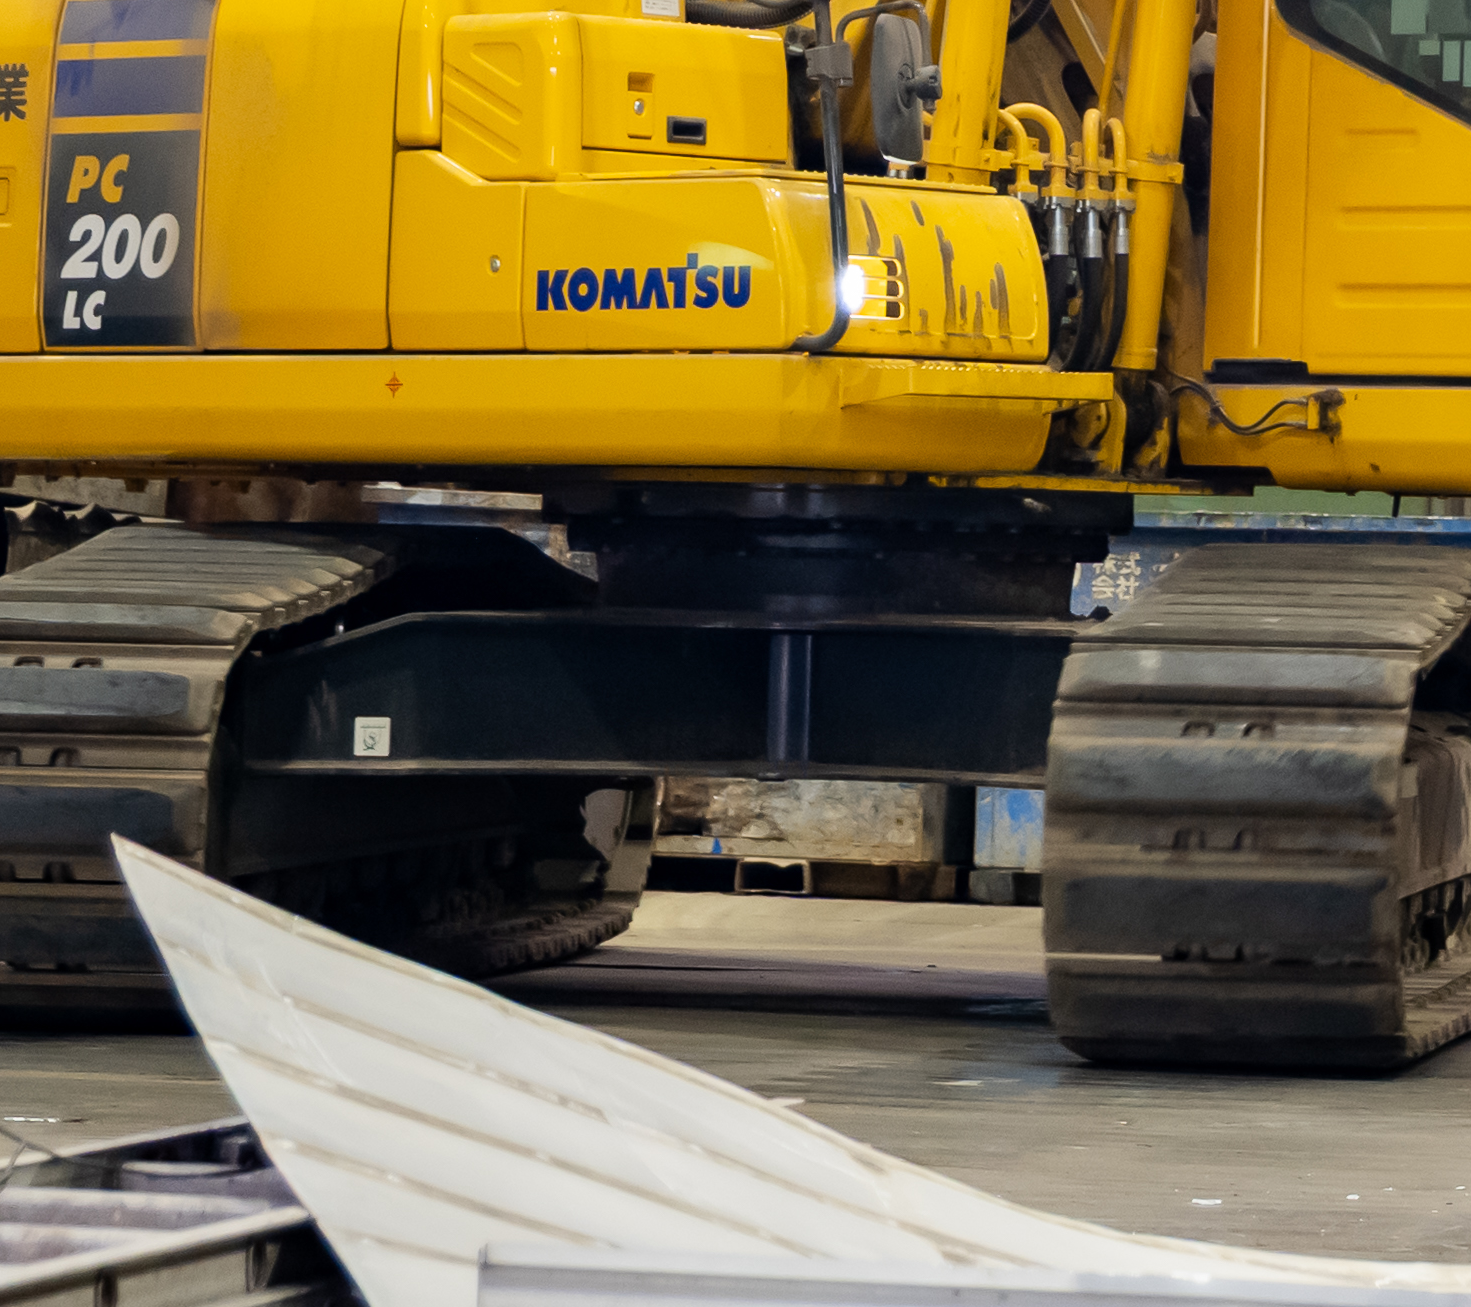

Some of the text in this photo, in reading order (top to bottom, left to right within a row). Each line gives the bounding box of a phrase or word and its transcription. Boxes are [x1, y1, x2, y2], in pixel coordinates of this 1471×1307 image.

[65, 153, 131, 204] PC
[60, 212, 181, 280] 200
[62, 289, 107, 331] LC
[535, 252, 752, 313] KOMATSU
